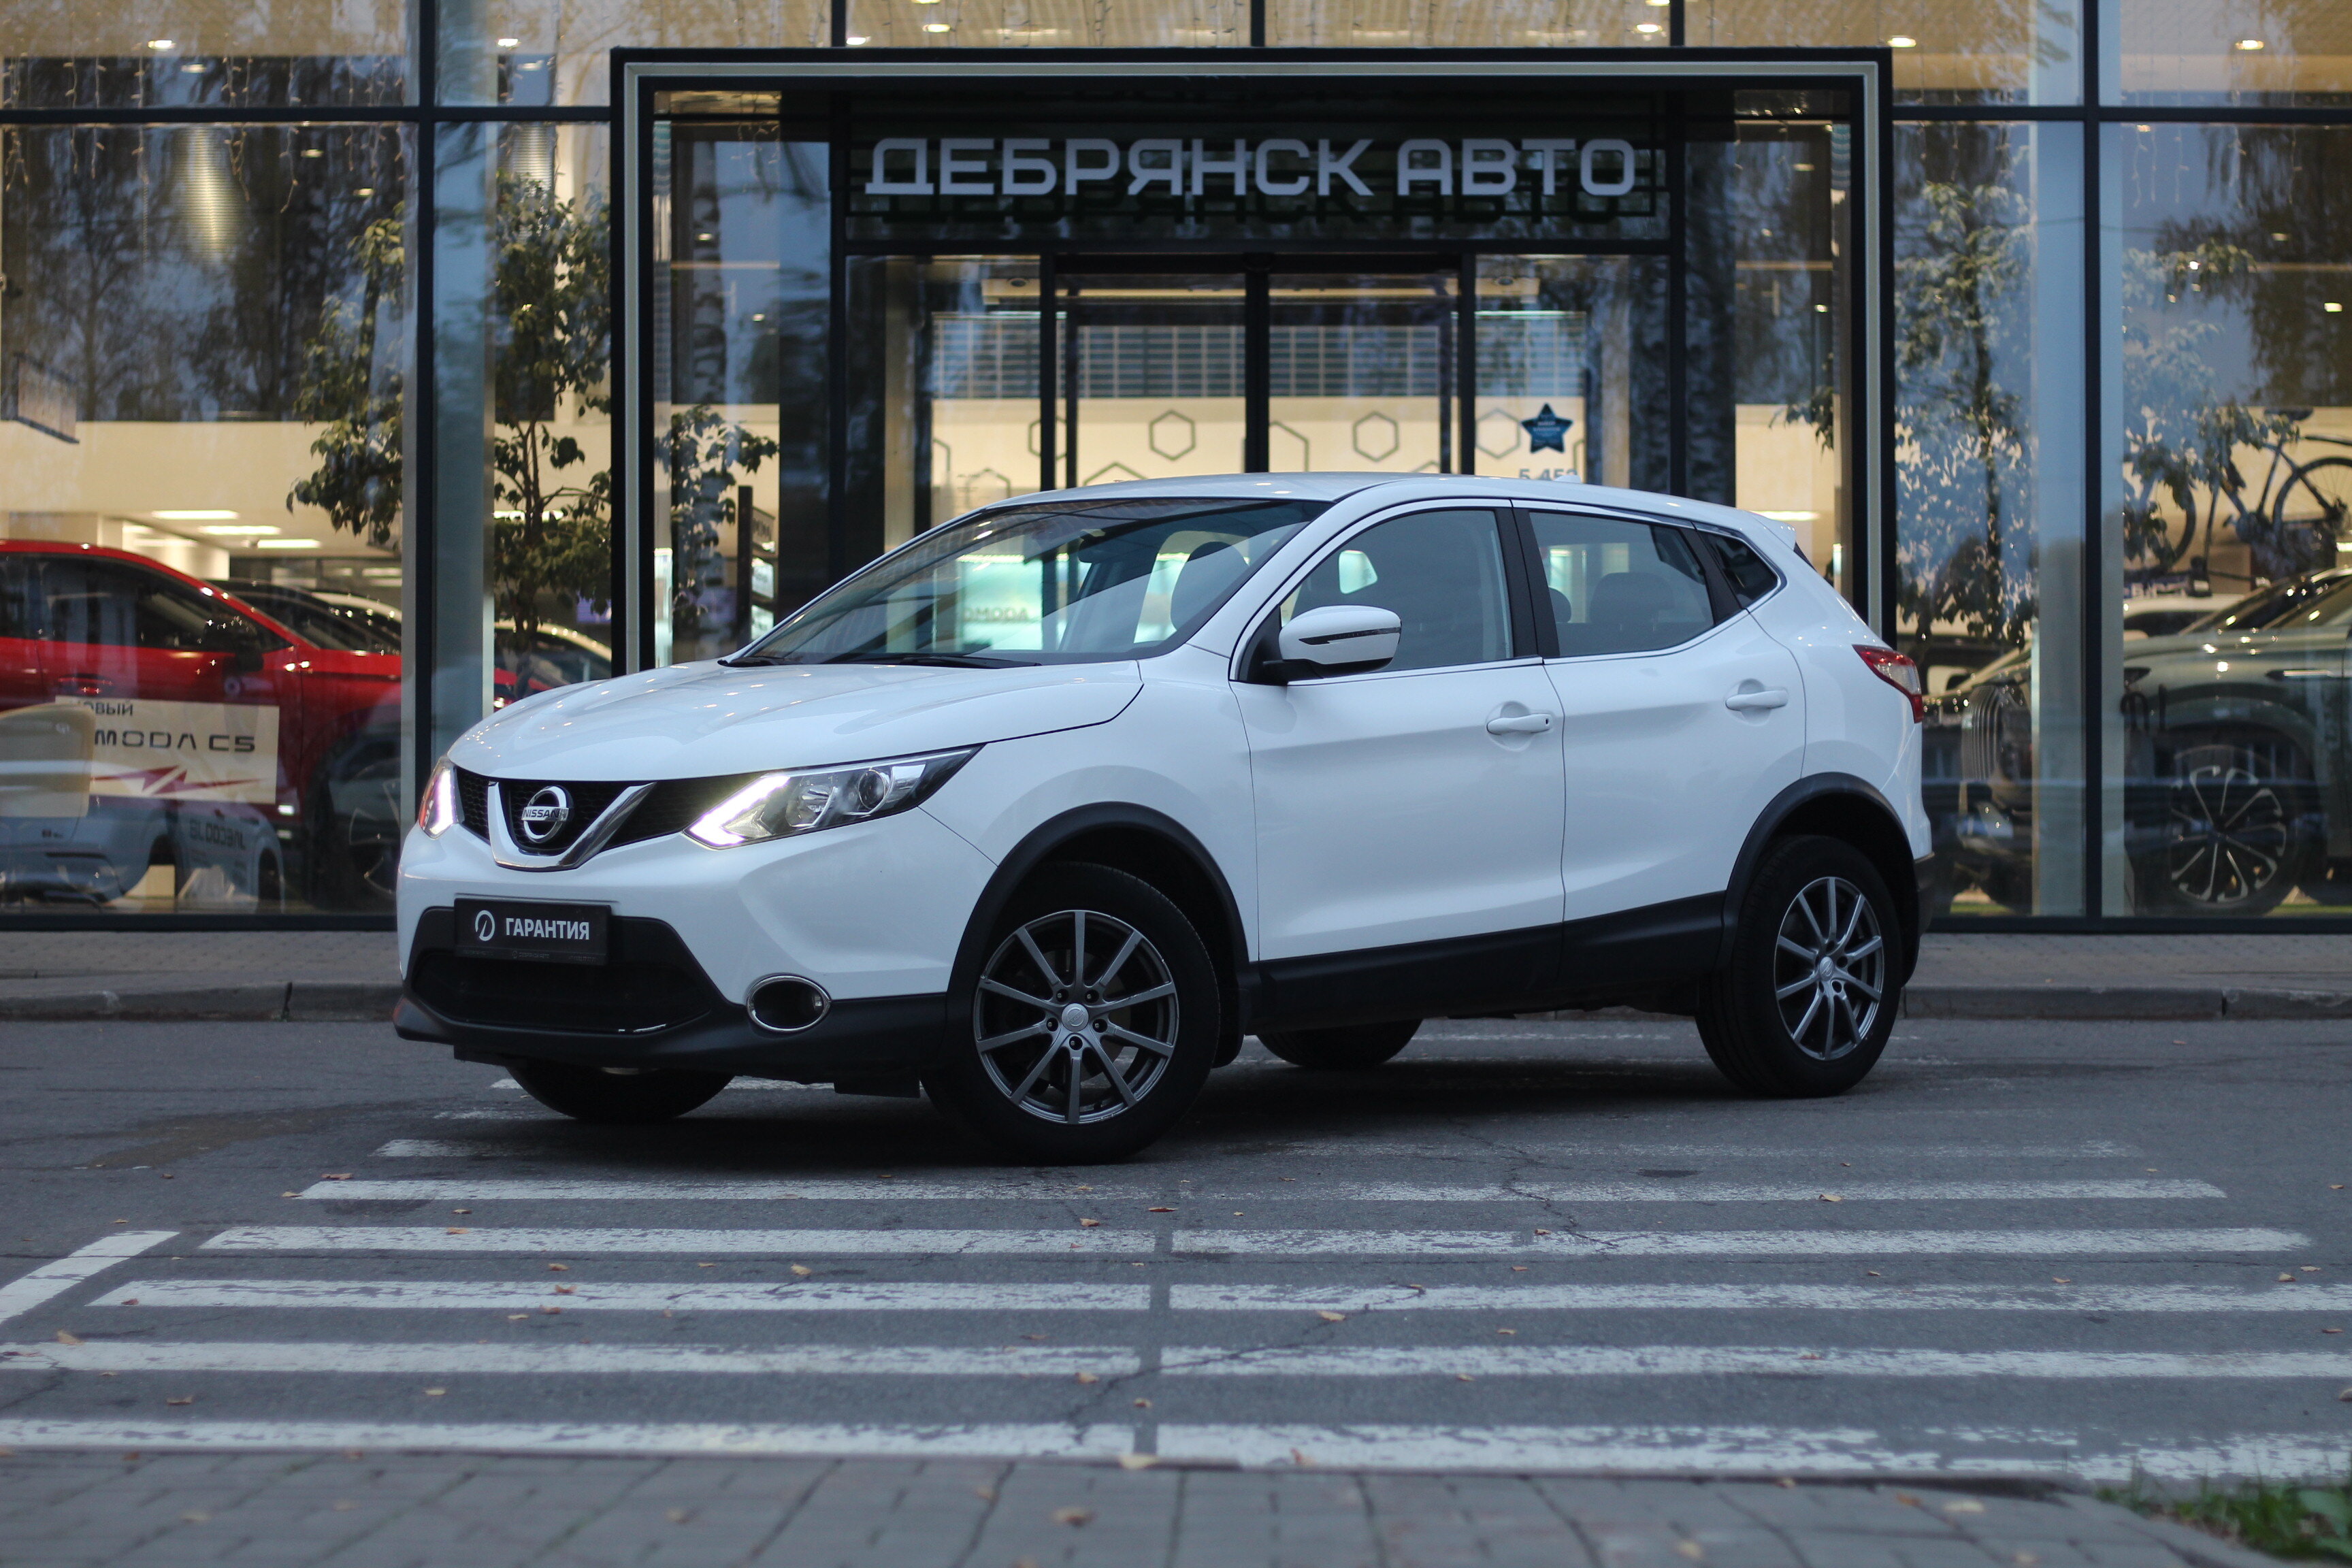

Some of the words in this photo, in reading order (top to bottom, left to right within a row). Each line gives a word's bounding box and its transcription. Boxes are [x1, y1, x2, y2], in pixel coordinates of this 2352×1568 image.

[864, 137, 1374, 196] ДЕБРЯНСК
[1397, 138, 1635, 196] АВТО
[209, 734, 255, 753] C5
[523, 809, 560, 818] NISSAN
[506, 917, 589, 940] ГАРАНТИЯ
